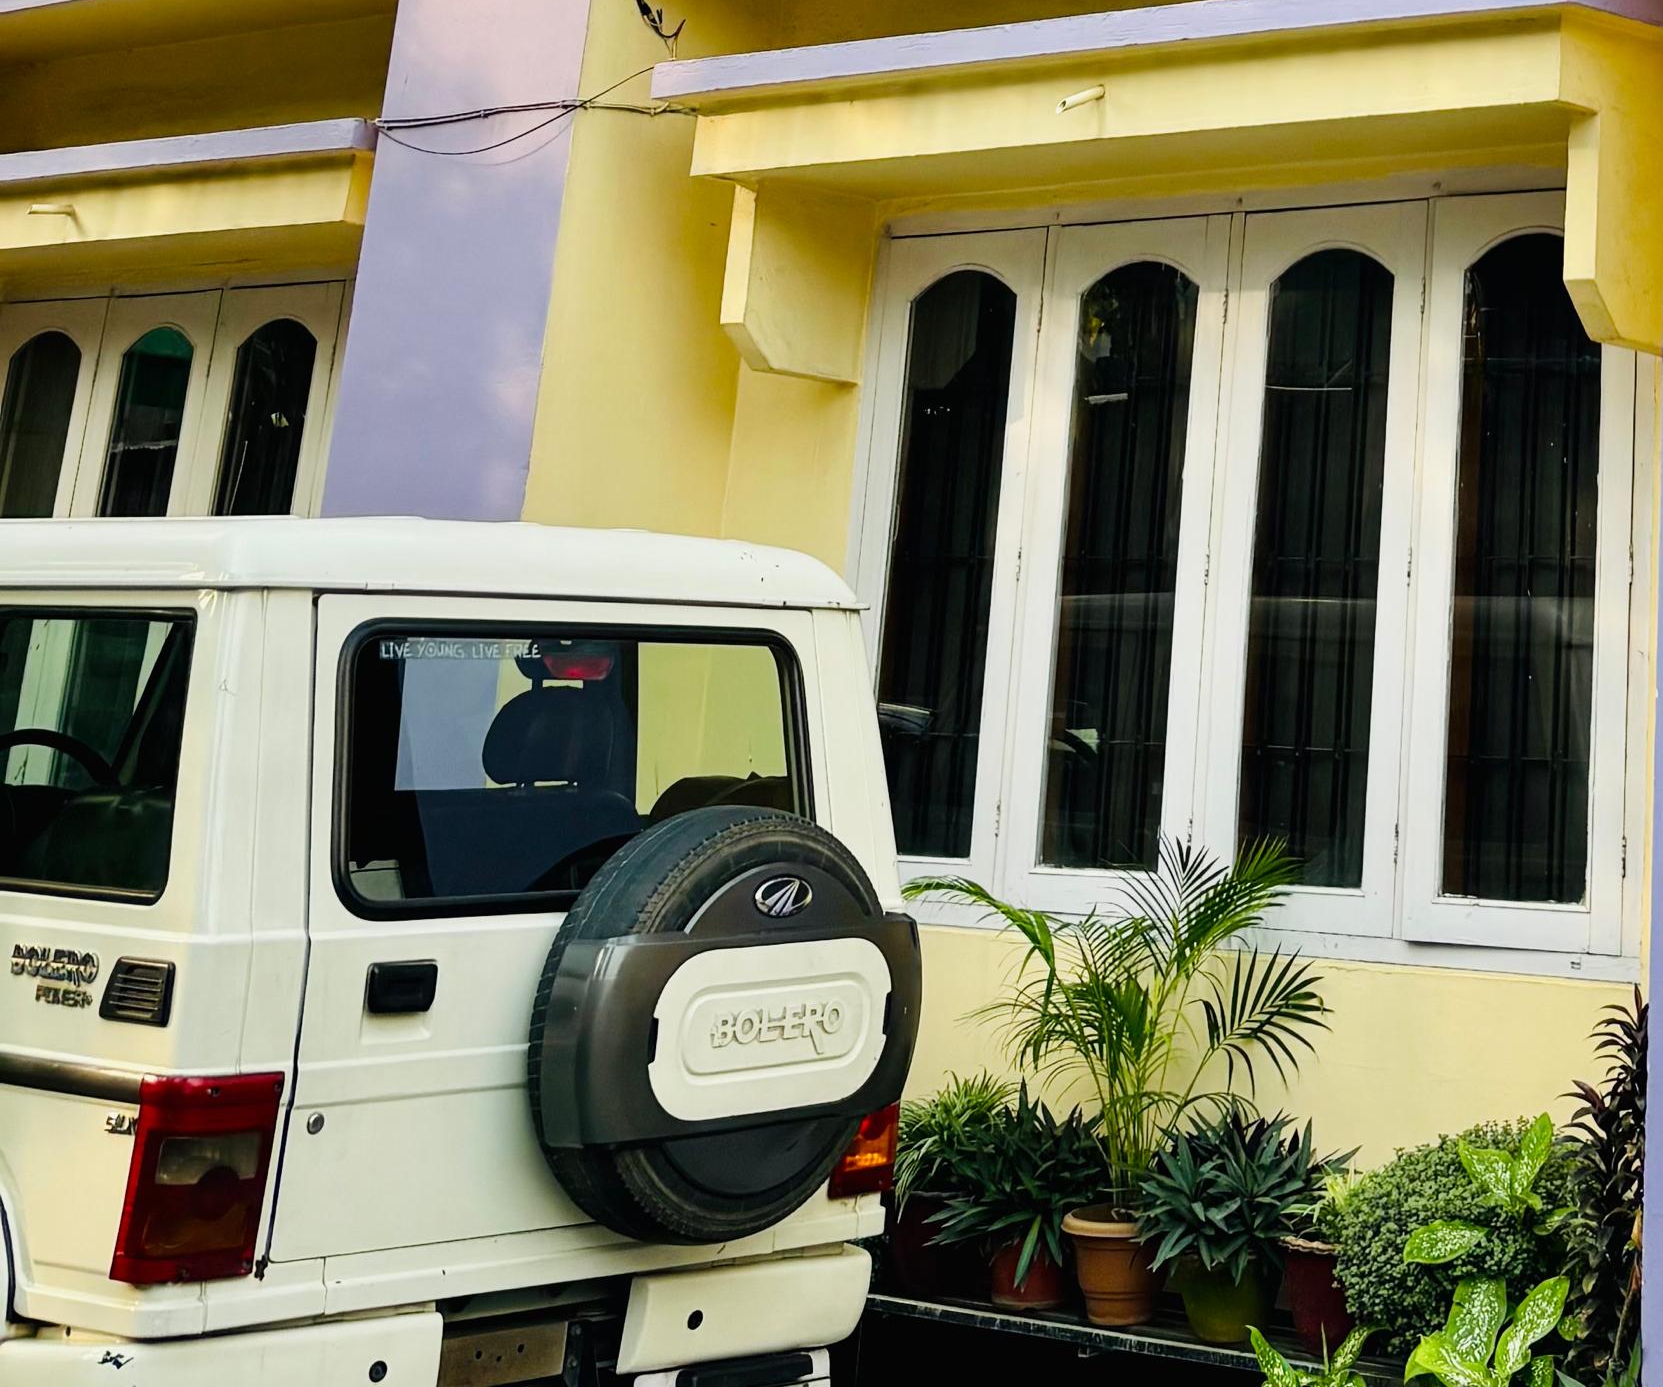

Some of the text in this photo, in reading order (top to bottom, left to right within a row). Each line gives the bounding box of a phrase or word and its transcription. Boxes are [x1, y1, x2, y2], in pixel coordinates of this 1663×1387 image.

[381, 641, 542, 659] LIVE YOUNG LIVE FREE
[11, 943, 100, 987] BOLERO
[710, 999, 847, 1056] BOLERO
